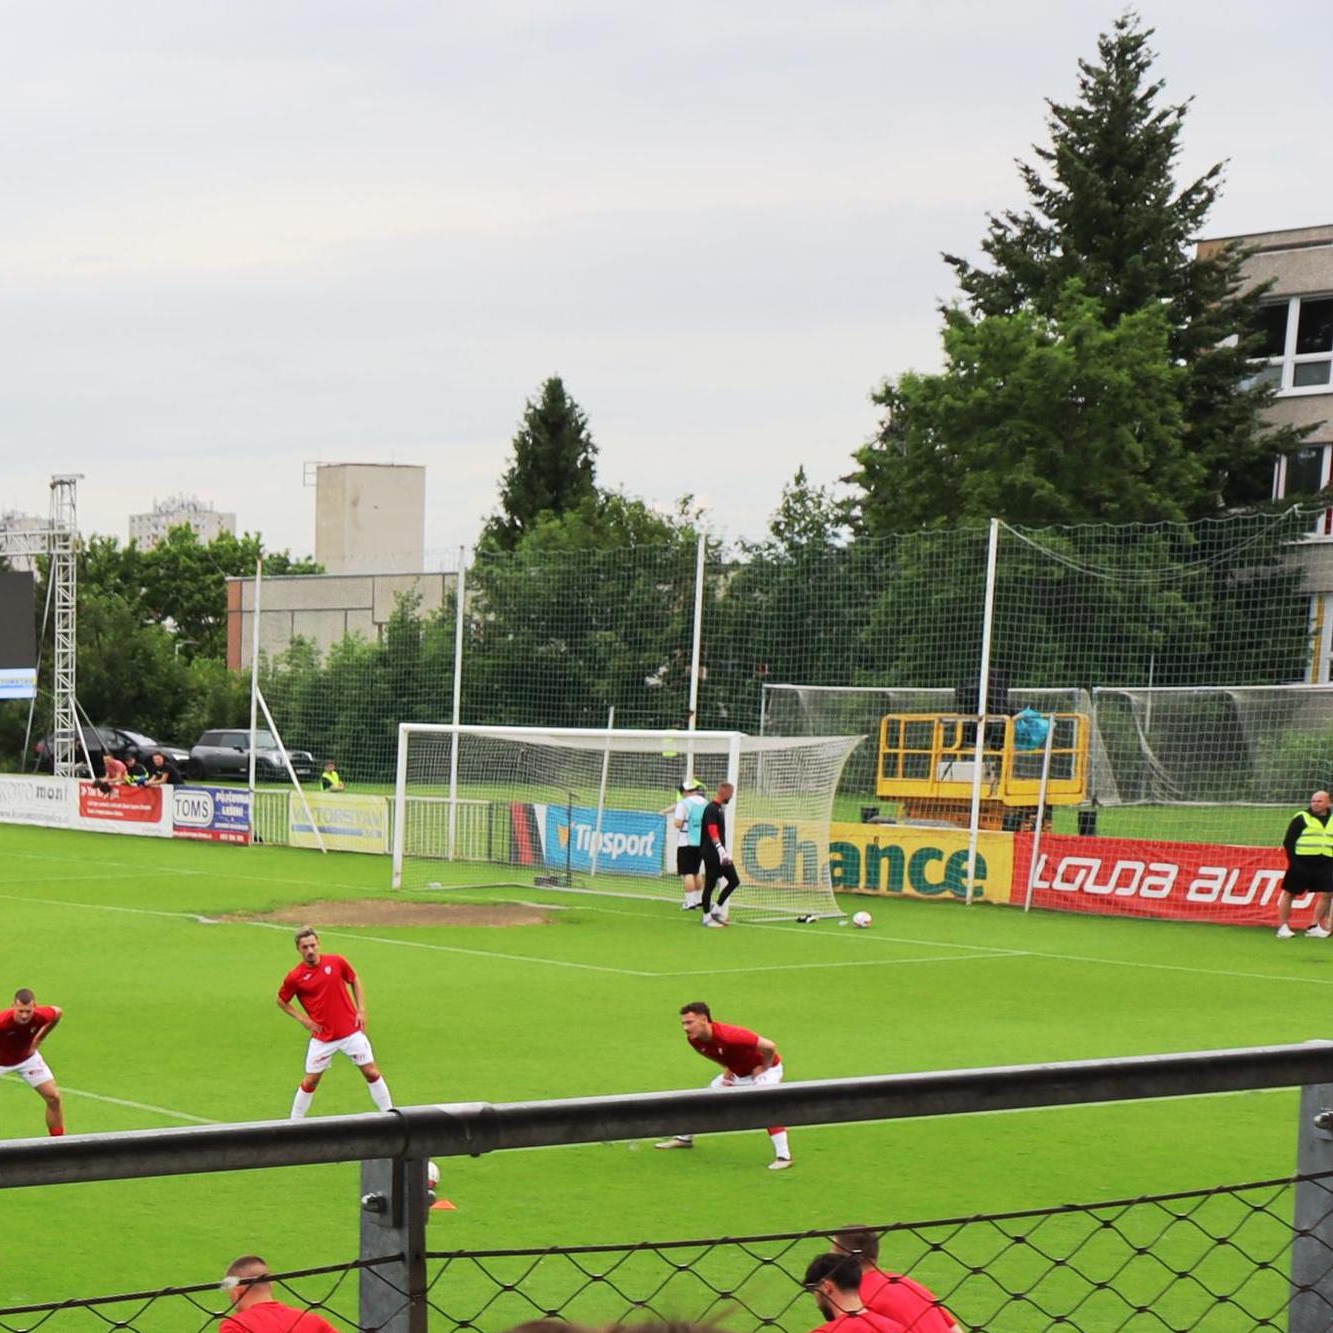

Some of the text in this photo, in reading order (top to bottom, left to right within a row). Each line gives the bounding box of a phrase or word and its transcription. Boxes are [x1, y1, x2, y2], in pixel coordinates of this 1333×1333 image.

[175, 798, 209, 819] TOMS
[575, 824, 655, 860] Tipsport
[741, 823, 988, 898] Chance
